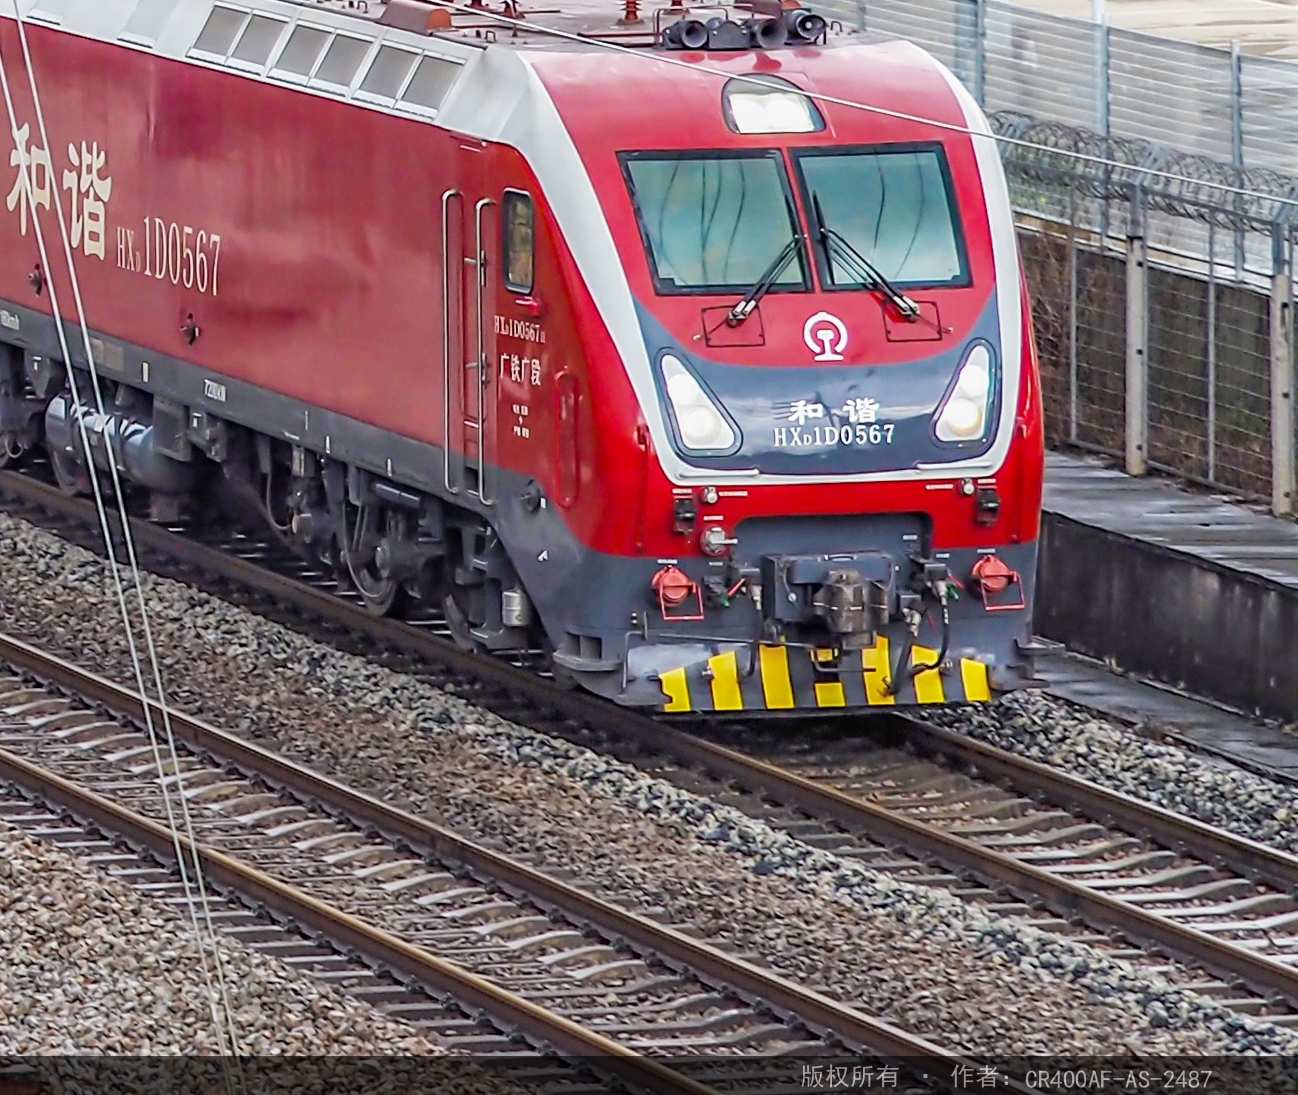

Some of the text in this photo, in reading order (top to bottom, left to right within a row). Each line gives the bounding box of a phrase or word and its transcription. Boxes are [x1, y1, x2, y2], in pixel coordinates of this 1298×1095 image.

[6, 122, 112, 261] 和谐
[788, 397, 880, 425] 和谐
[773, 424, 895, 447] HXD1D0567
